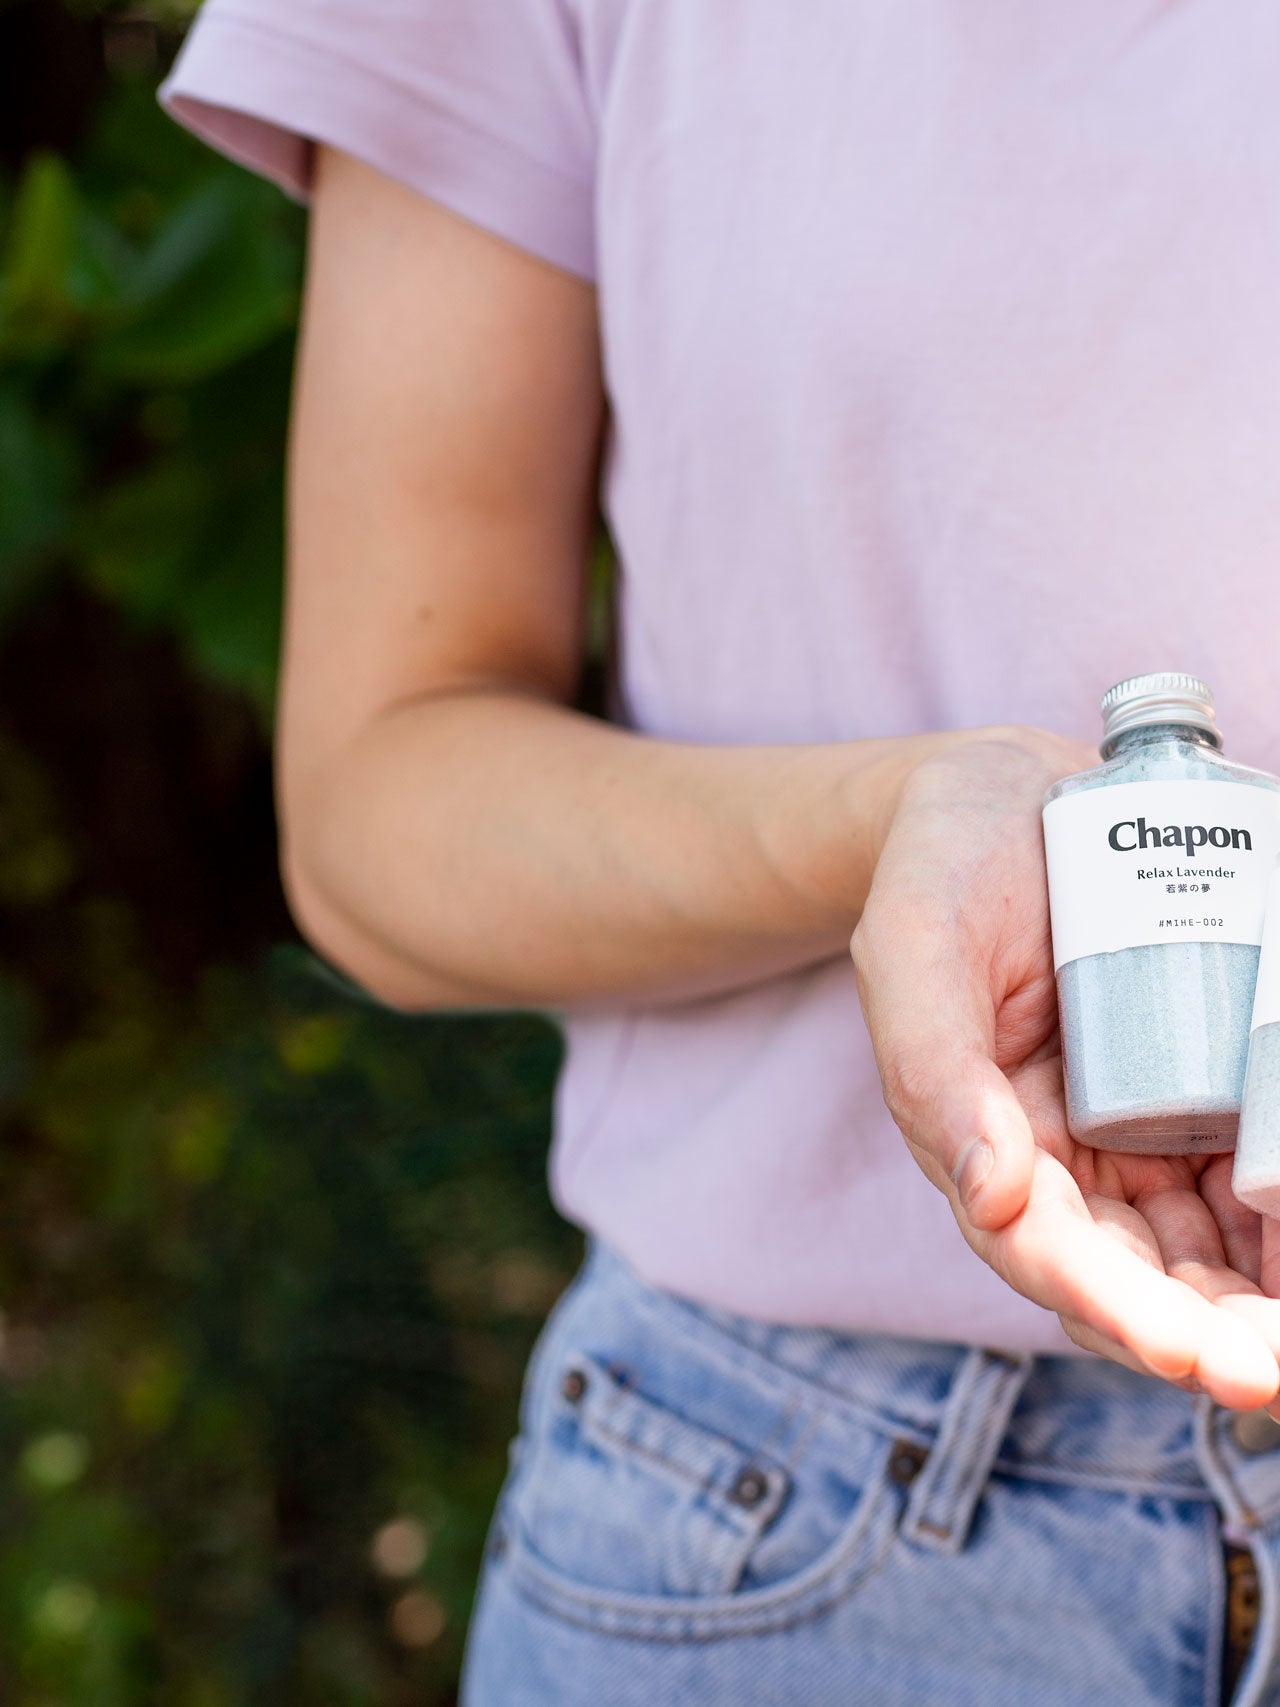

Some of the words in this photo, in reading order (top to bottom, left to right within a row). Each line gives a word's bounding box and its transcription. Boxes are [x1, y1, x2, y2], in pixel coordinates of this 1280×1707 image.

[1107, 817, 1253, 857] Chapon
[1137, 867, 1174, 880] Relax
[1176, 866, 1236, 879] Lavender
[1165, 883, 1211, 894] 若紫の夢
[1159, 918, 1224, 928] #MIHE-002
